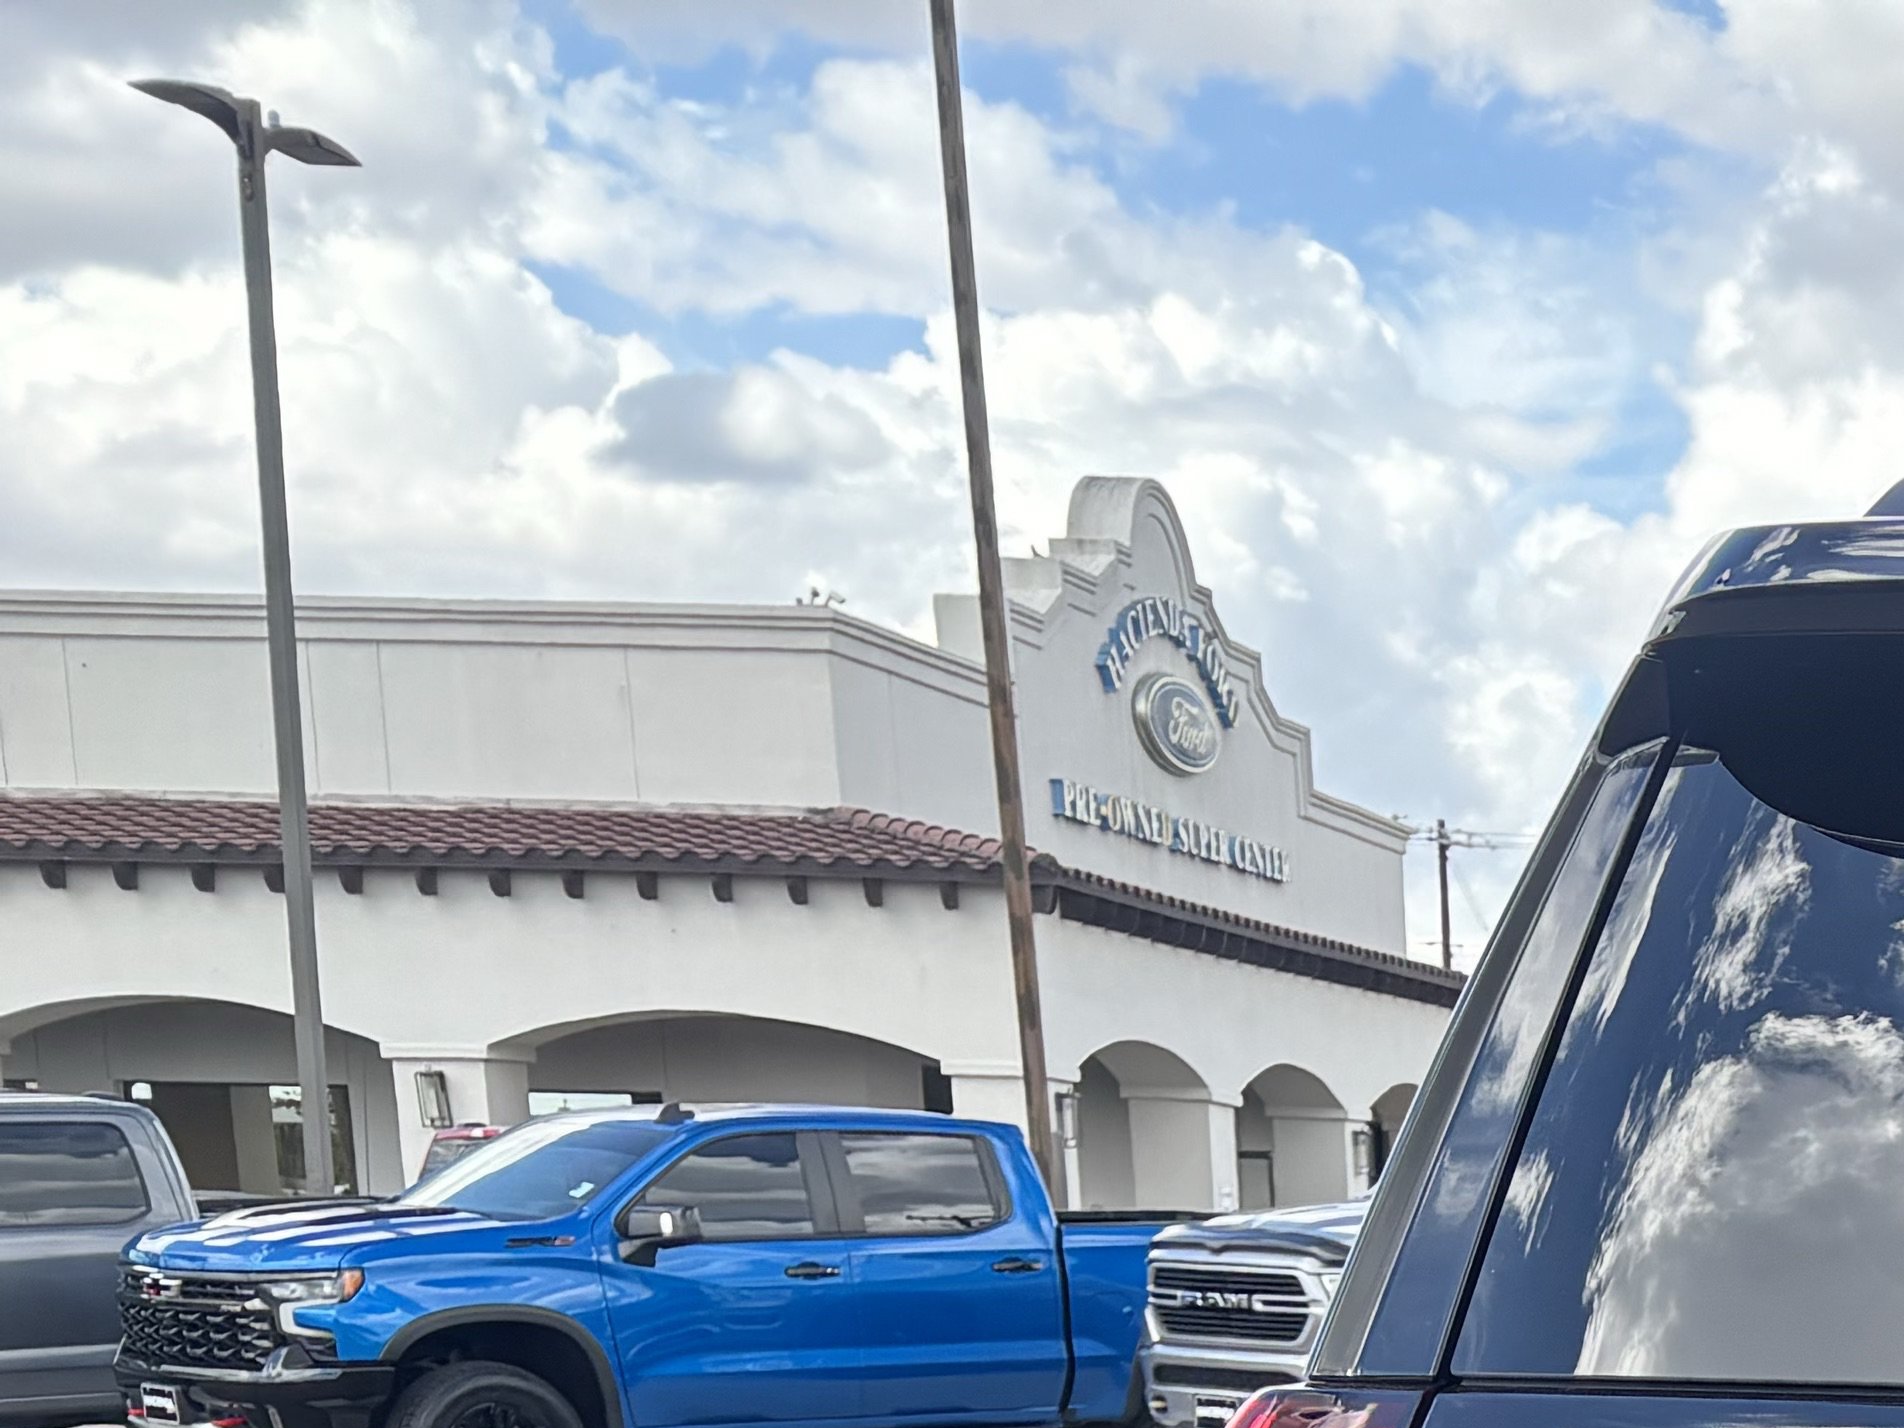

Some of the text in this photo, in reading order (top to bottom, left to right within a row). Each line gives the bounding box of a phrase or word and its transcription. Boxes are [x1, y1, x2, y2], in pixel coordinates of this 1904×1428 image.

[1168, 696, 1210, 754] Ford
[1062, 778, 1291, 883] PRE-OWNED SUPER CENTER
[1179, 1290, 1249, 1310] RAM
